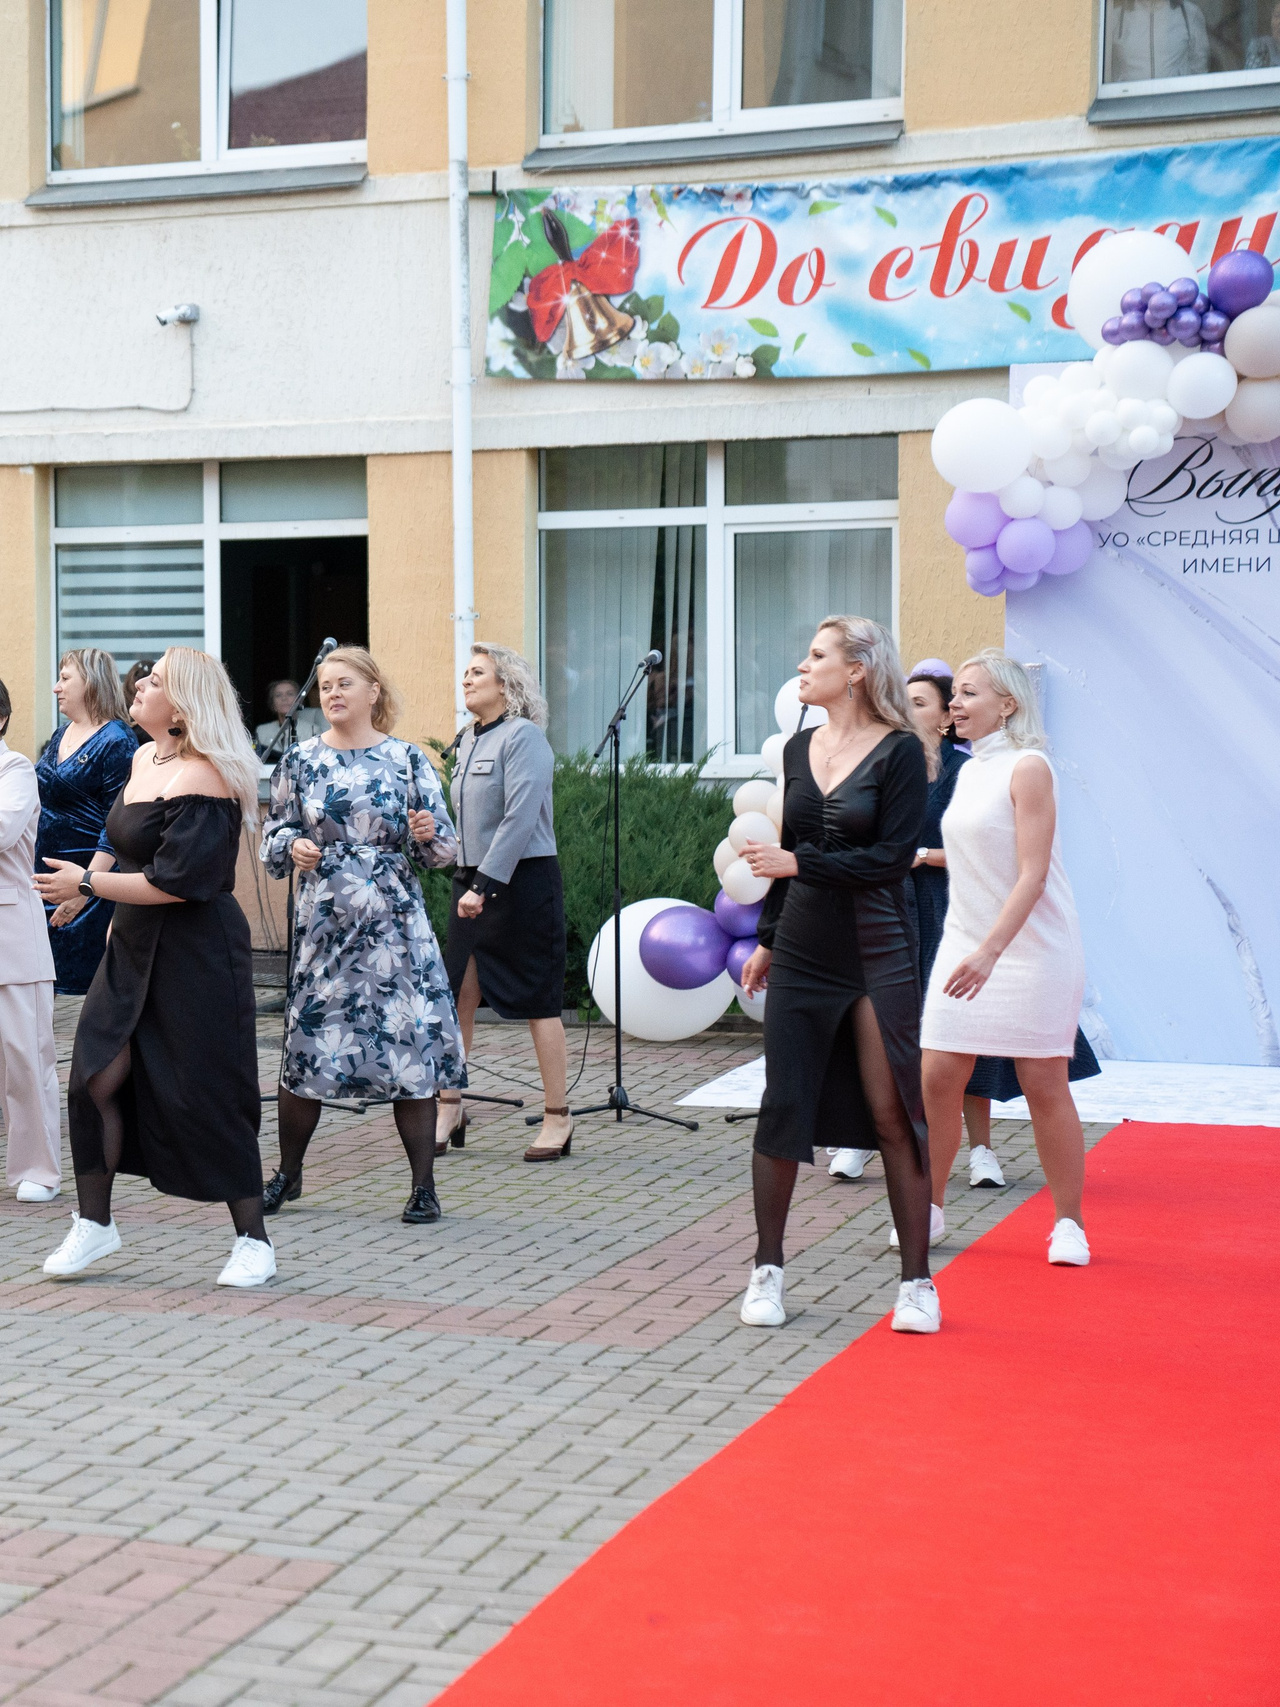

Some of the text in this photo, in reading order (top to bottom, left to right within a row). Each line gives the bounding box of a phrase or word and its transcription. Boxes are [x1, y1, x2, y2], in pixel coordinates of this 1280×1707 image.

[677, 216, 836, 309] До
[1098, 531, 1130, 549] УО
[1136, 528, 1259, 549] «СРЕДНЯЯ
[1182, 556, 1271, 574] ИМЕНИ
